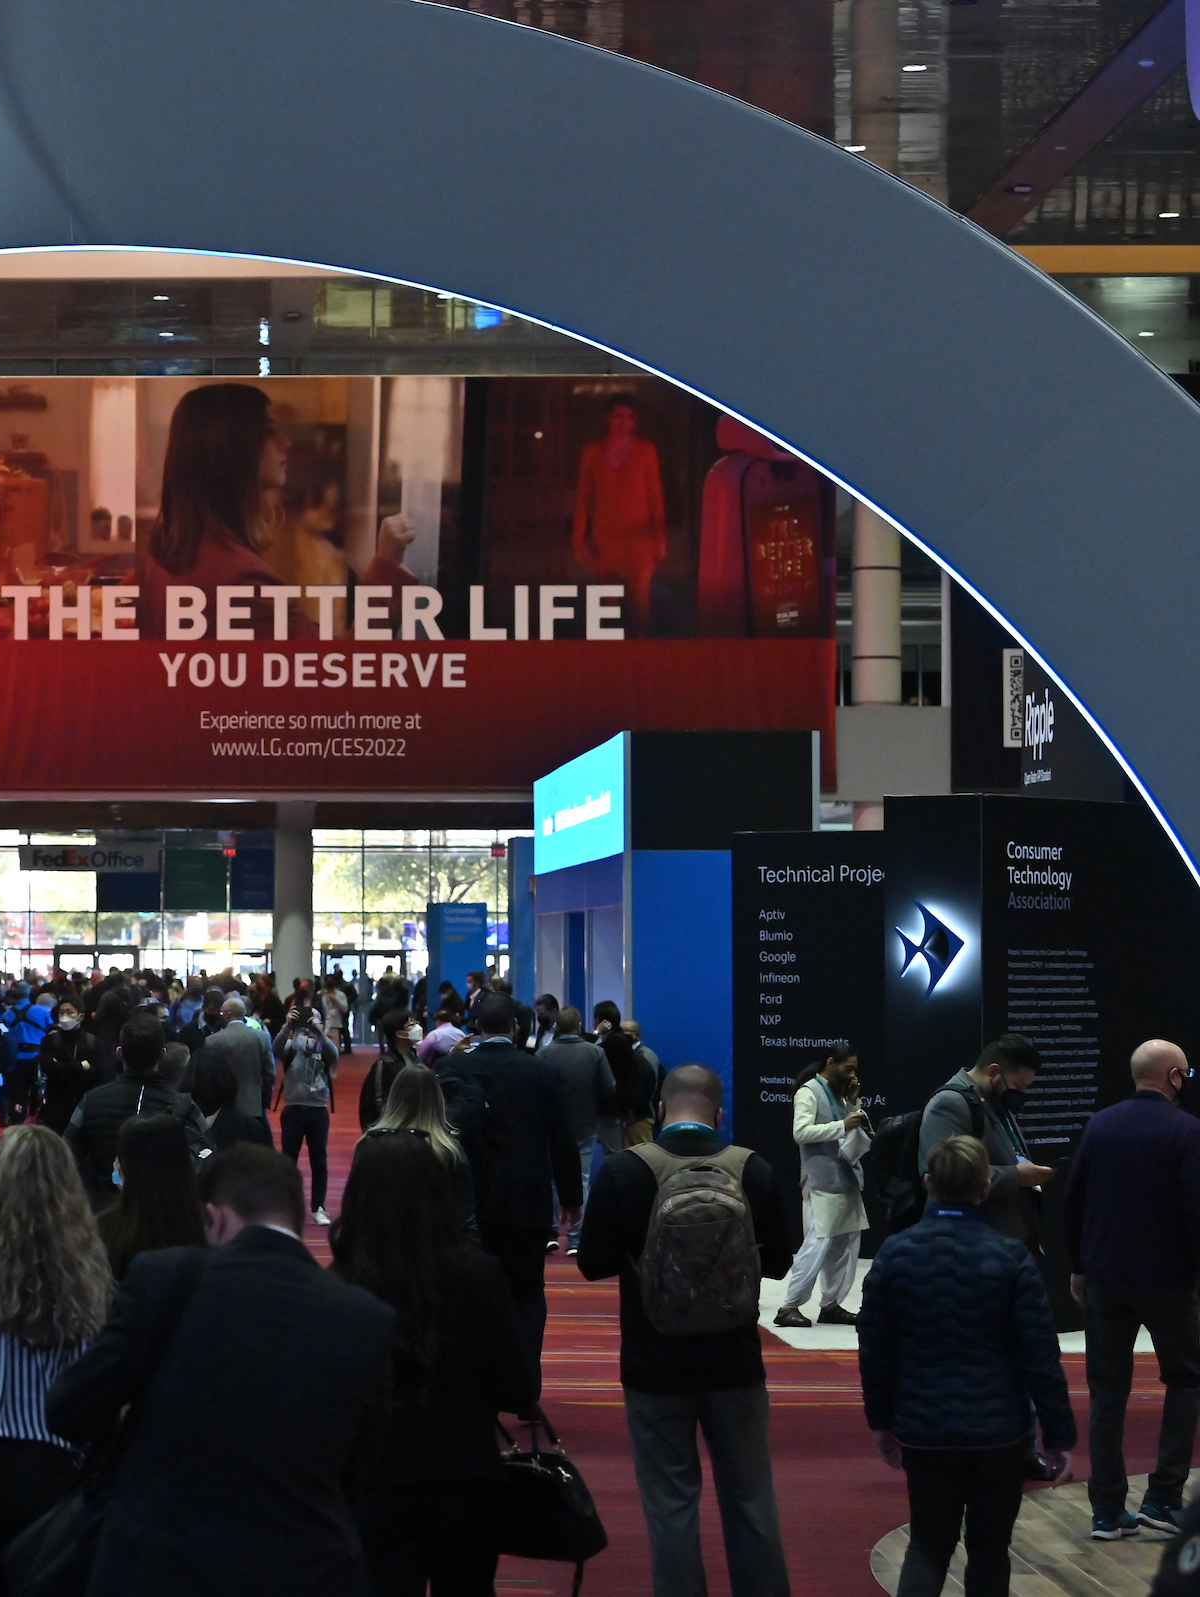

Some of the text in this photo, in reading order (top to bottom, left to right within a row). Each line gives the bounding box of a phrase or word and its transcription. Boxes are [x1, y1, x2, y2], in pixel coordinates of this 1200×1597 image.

[0, 584, 626, 642] THE BETTER LIFE
[159, 652, 468, 689] YOU DESERVE
[200, 710, 422, 733] Experience so much more at
[1025, 687, 1055, 761] Ripple
[211, 738, 406, 759] www.LG.com/CES2022
[32, 848, 145, 868] FedEx Office
[1006, 840, 1063, 861] Consumer
[758, 865, 835, 884] Technical
[1007, 864, 1073, 891] Technology
[1007, 891, 1071, 910] Association
[759, 909, 786, 922] Aptiv
[759, 930, 794, 941] Blumio
[759, 951, 797, 965] Google
[759, 972, 801, 984] Infineon
[760, 993, 783, 1005] Ford
[760, 1014, 782, 1026] NXP
[760, 1035, 788, 1047] Texas
[760, 1075, 786, 1085] Hosted
